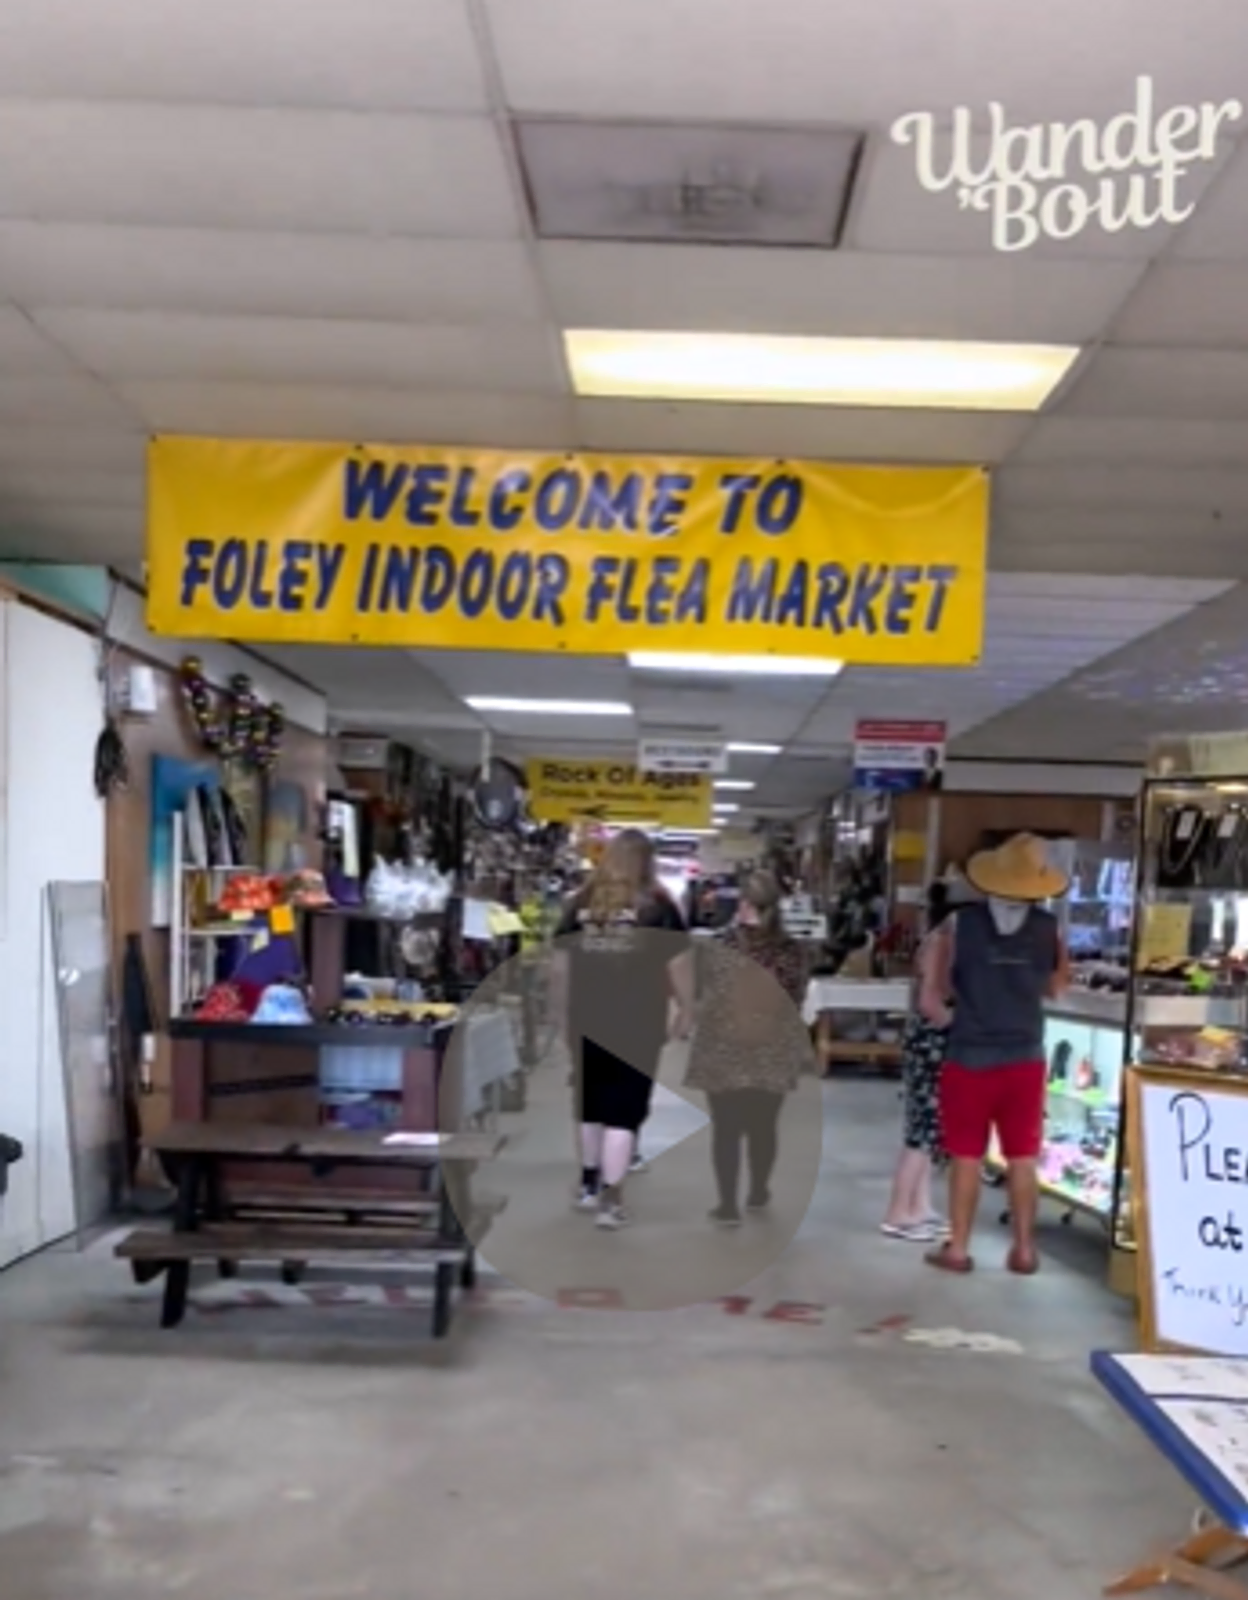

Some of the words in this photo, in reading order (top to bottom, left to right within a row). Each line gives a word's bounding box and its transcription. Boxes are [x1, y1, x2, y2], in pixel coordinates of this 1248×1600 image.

[343, 458, 694, 536] WELCOME
[718, 474, 804, 536] TO
[180, 537, 345, 612] FOLEY
[356, 543, 570, 627] INDOOR
[585, 555, 711, 624] FLEA
[725, 555, 959, 636] MARKET
[541, 762, 598, 784] Rock
[1168, 1091, 1248, 1183] PLE
[1199, 1210, 1243, 1252] at
